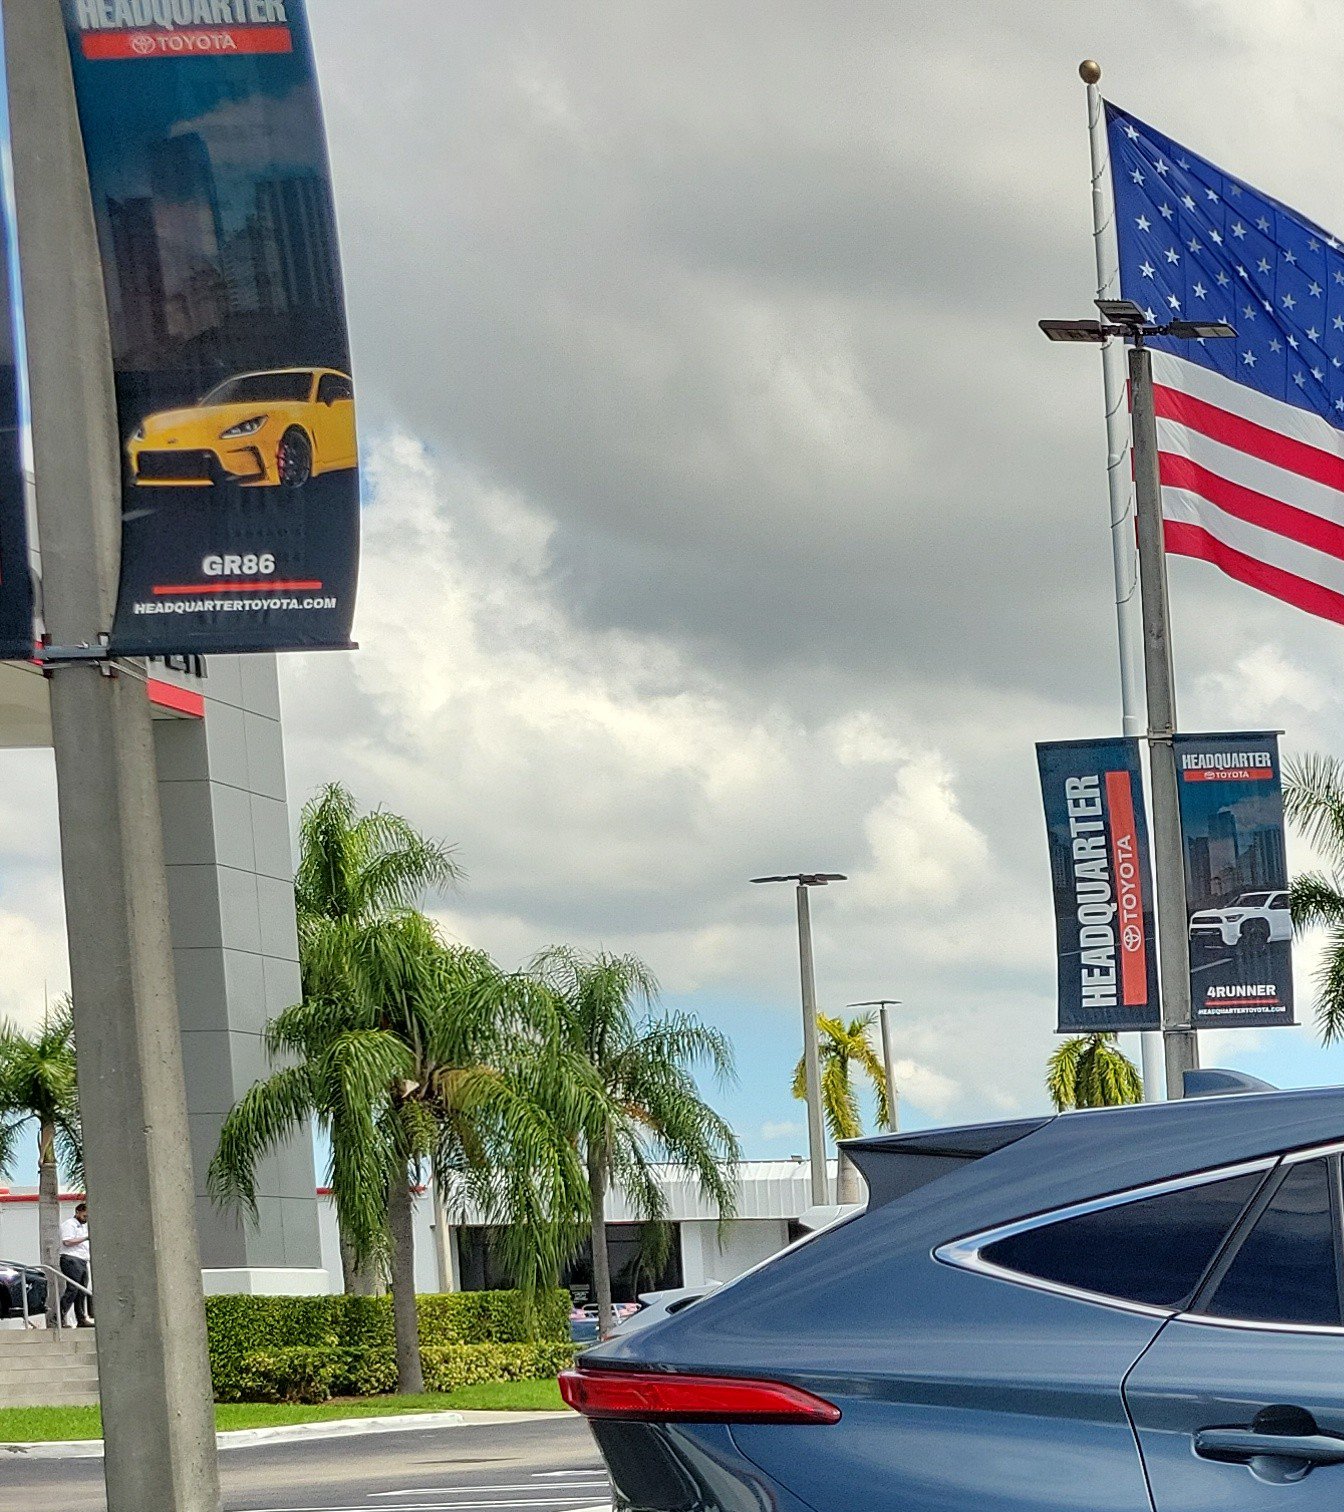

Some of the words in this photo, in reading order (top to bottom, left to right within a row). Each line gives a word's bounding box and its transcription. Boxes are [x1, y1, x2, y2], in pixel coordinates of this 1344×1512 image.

[158, 34, 238, 51] TOYOTA
[202, 554, 276, 576] GR86
[134, 598, 337, 615] HEADQUARTERTOYOTA.COM
[1182, 751, 1272, 770] HEADQUARTER
[1216, 771, 1250, 779] TOYOTA
[1117, 834, 1138, 923] TOYOTA
[1065, 774, 1117, 1008] HEADQUARTER
[1206, 984, 1277, 998] 4RUNNER
[1197, 1005, 1287, 1015] HEADQUARTERTOYOTA.COM
